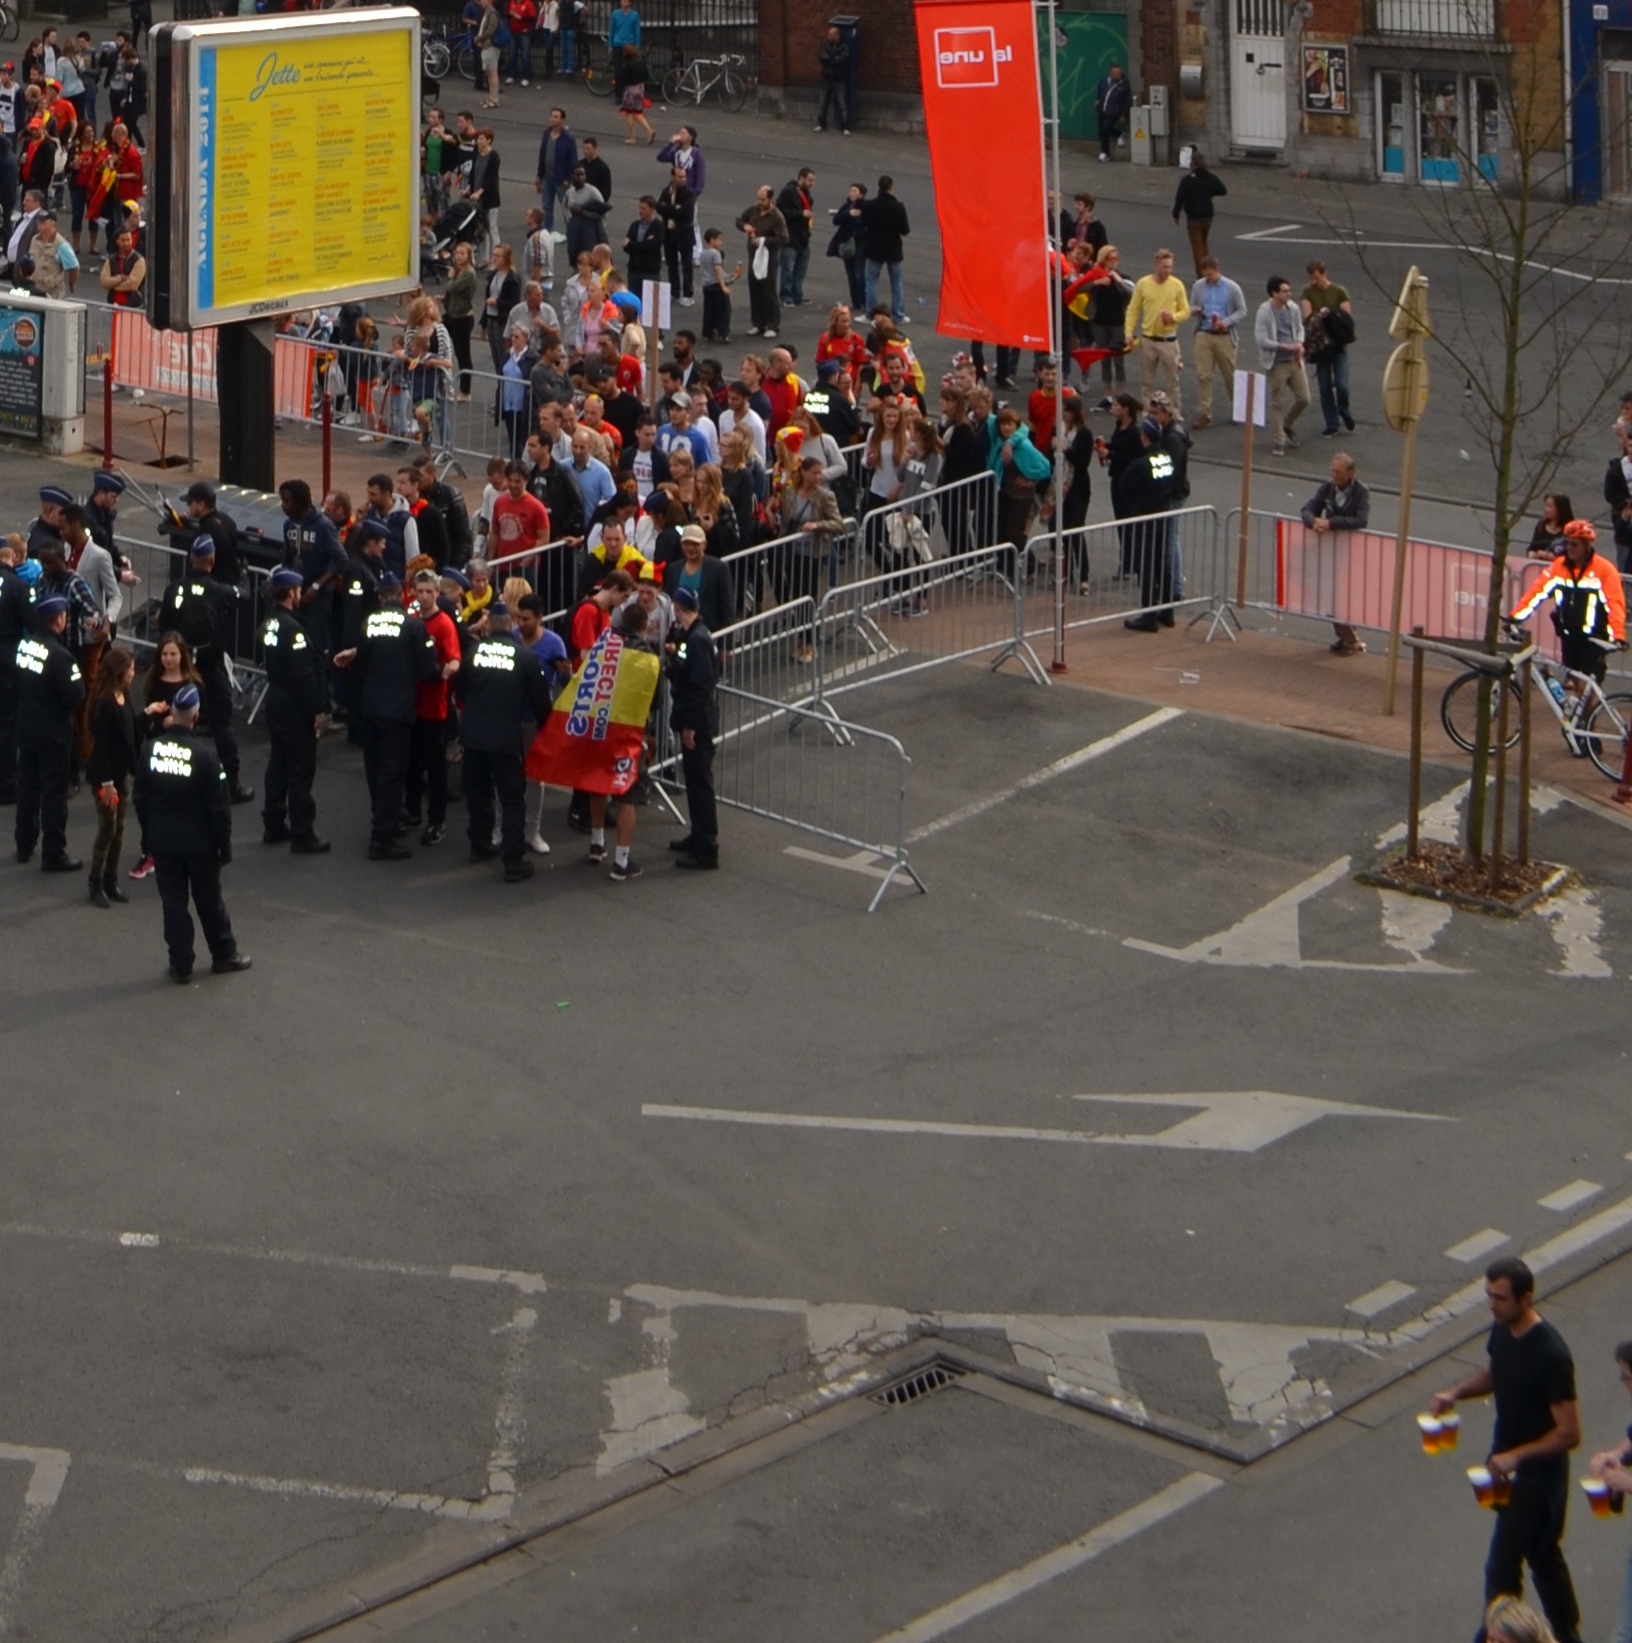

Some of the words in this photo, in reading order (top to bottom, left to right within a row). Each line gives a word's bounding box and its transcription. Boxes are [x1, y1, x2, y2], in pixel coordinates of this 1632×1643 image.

[249, 52, 301, 102] Jette
[249, 300, 289, 314] JCDecaux
[477, 642, 516, 657] Police
[473, 653, 515, 672] Politie
[153, 740, 192, 761] Police
[150, 756, 192, 777] Politie
